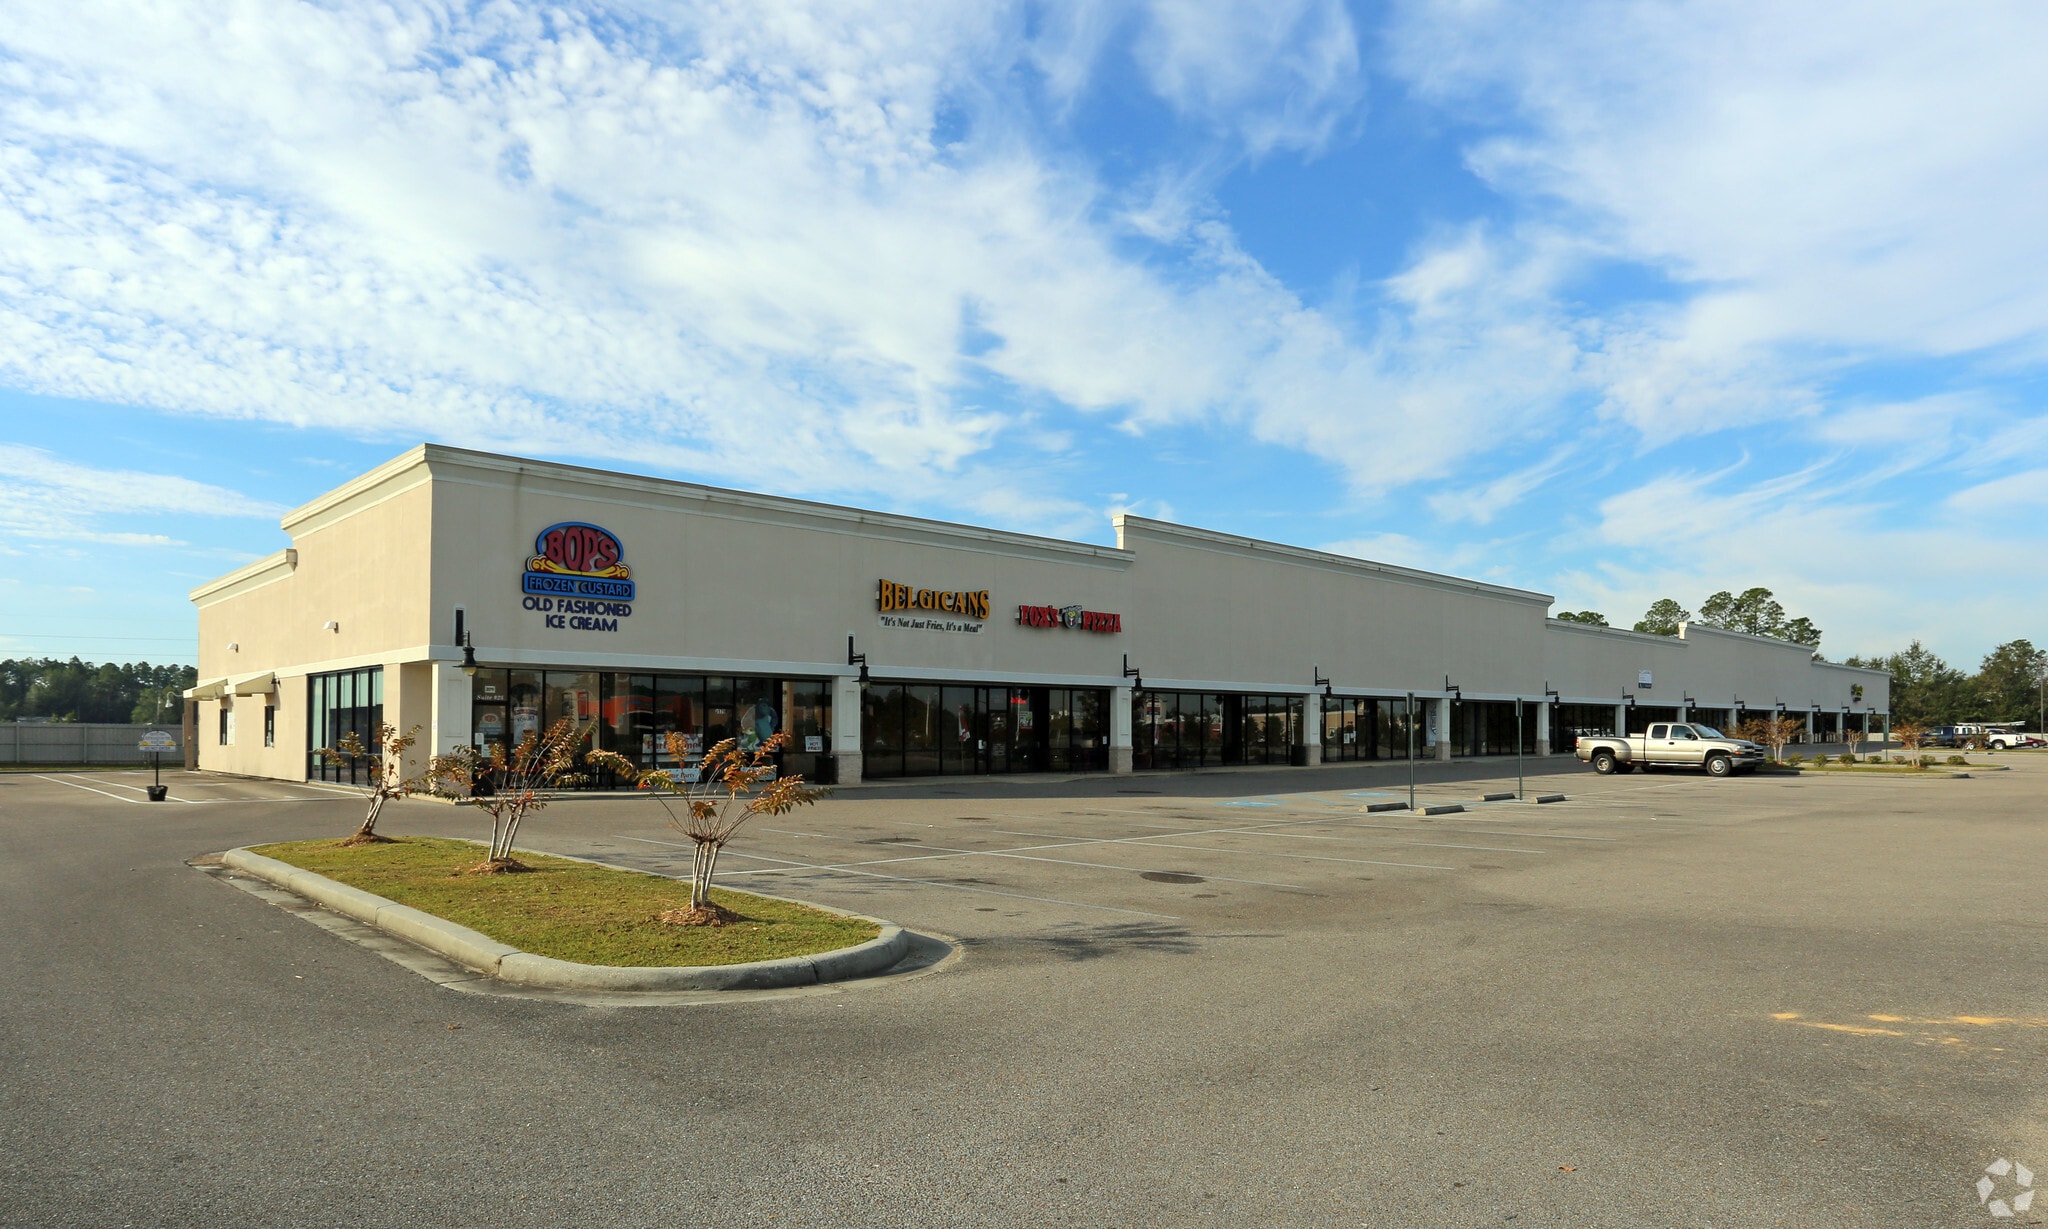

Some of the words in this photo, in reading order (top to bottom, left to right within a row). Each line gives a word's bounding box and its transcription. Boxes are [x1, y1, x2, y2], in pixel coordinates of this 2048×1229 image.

[545, 526, 617, 572] BOP'S
[529, 577, 576, 592] FROZEN
[580, 582, 630, 596] CUSTARD
[522, 596, 553, 612] OLD
[557, 599, 632, 617] FASHIONED
[879, 579, 990, 619] BELGICANS
[545, 614, 565, 629] ICE
[569, 615, 618, 632] CREAM
[898, 618, 910, 628] Not
[911, 619, 925, 629] Just
[946, 621, 957, 632] It's
[1020, 605, 1059, 628] FOX'S
[1081, 610, 1122, 633] PIZZA
